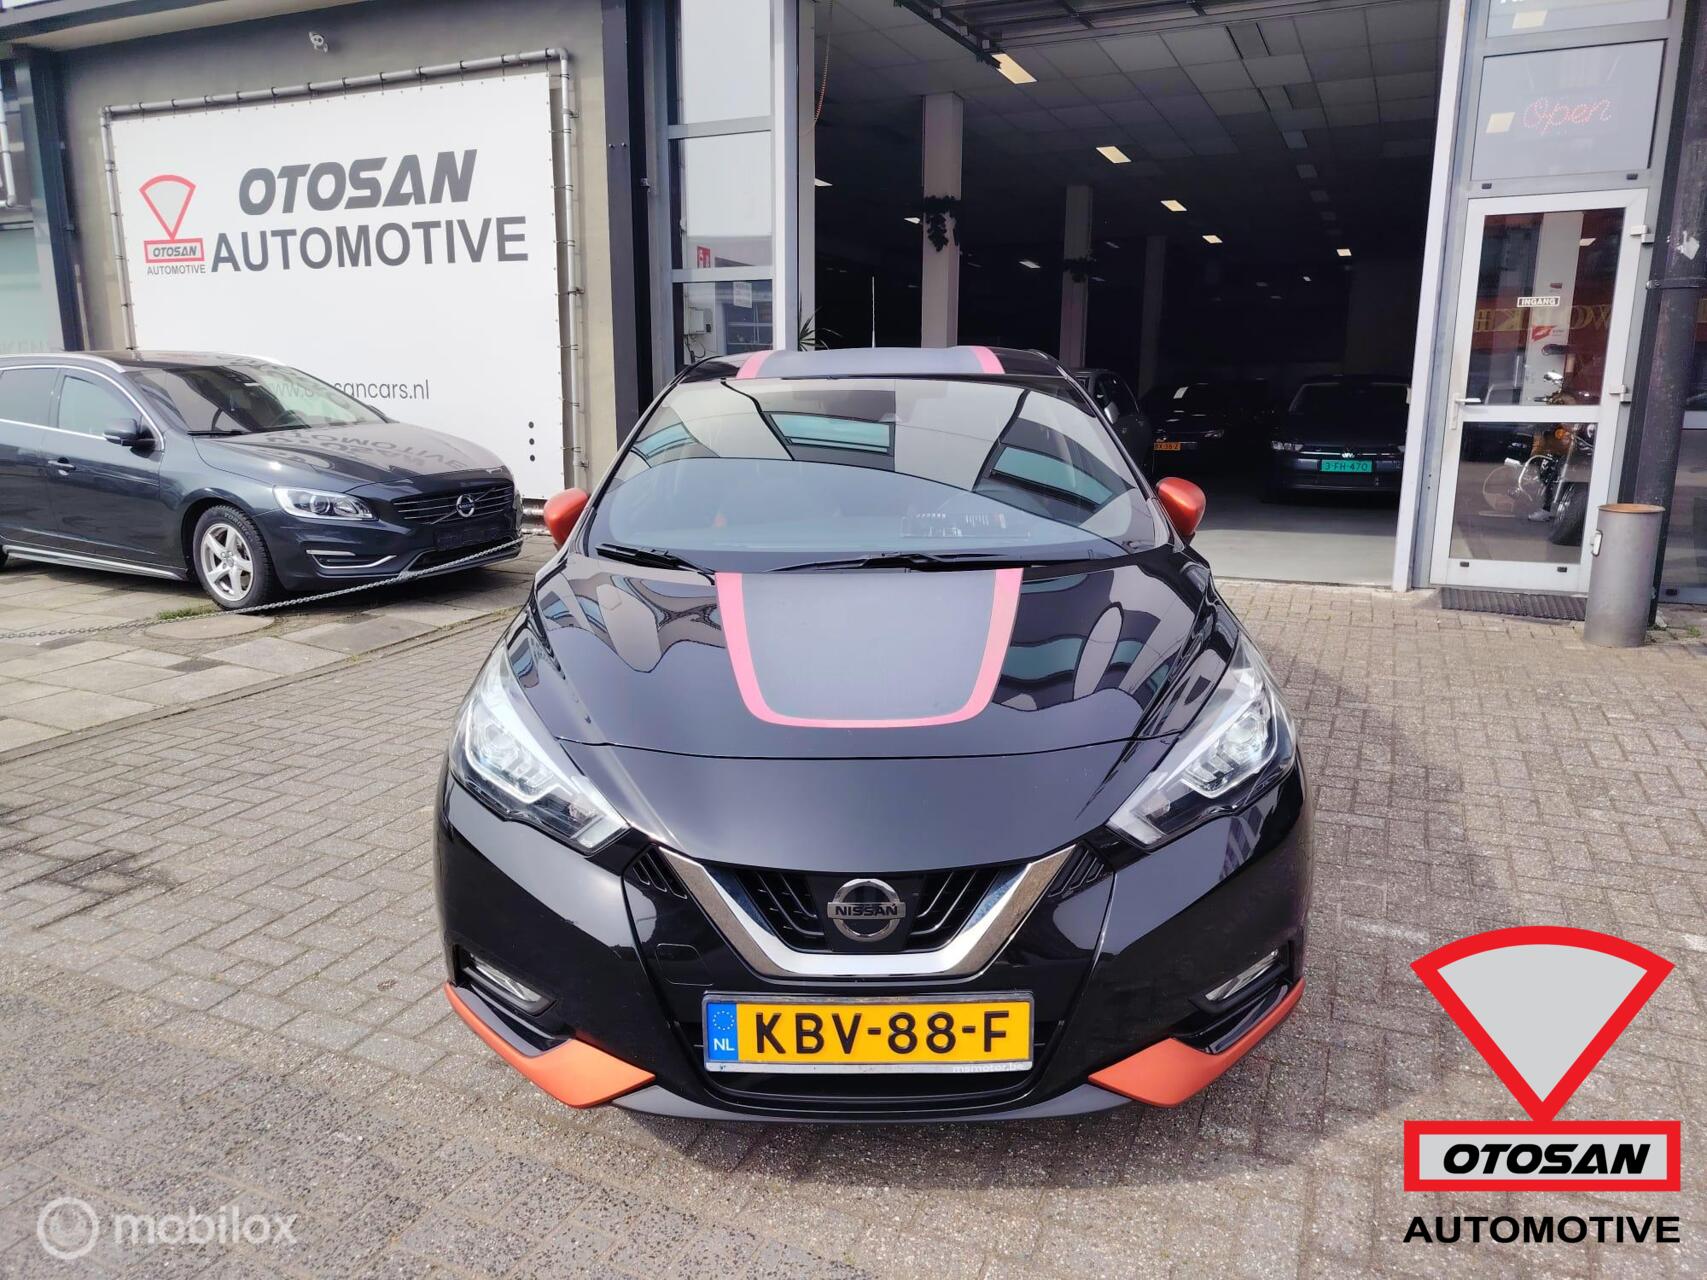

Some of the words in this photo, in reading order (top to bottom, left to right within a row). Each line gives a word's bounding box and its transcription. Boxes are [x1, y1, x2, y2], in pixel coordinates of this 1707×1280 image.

[239, 149, 477, 215] OTOSAN
[211, 216, 528, 272] AUTOMOTIVE
[153, 246, 197, 257] OTOSAN
[147, 265, 206, 275] AUTOMOTIVE
[835, 904, 898, 917] NISSAN
[755, 1010, 1010, 1055] KBV-88-F
[713, 1038, 735, 1051] NL
